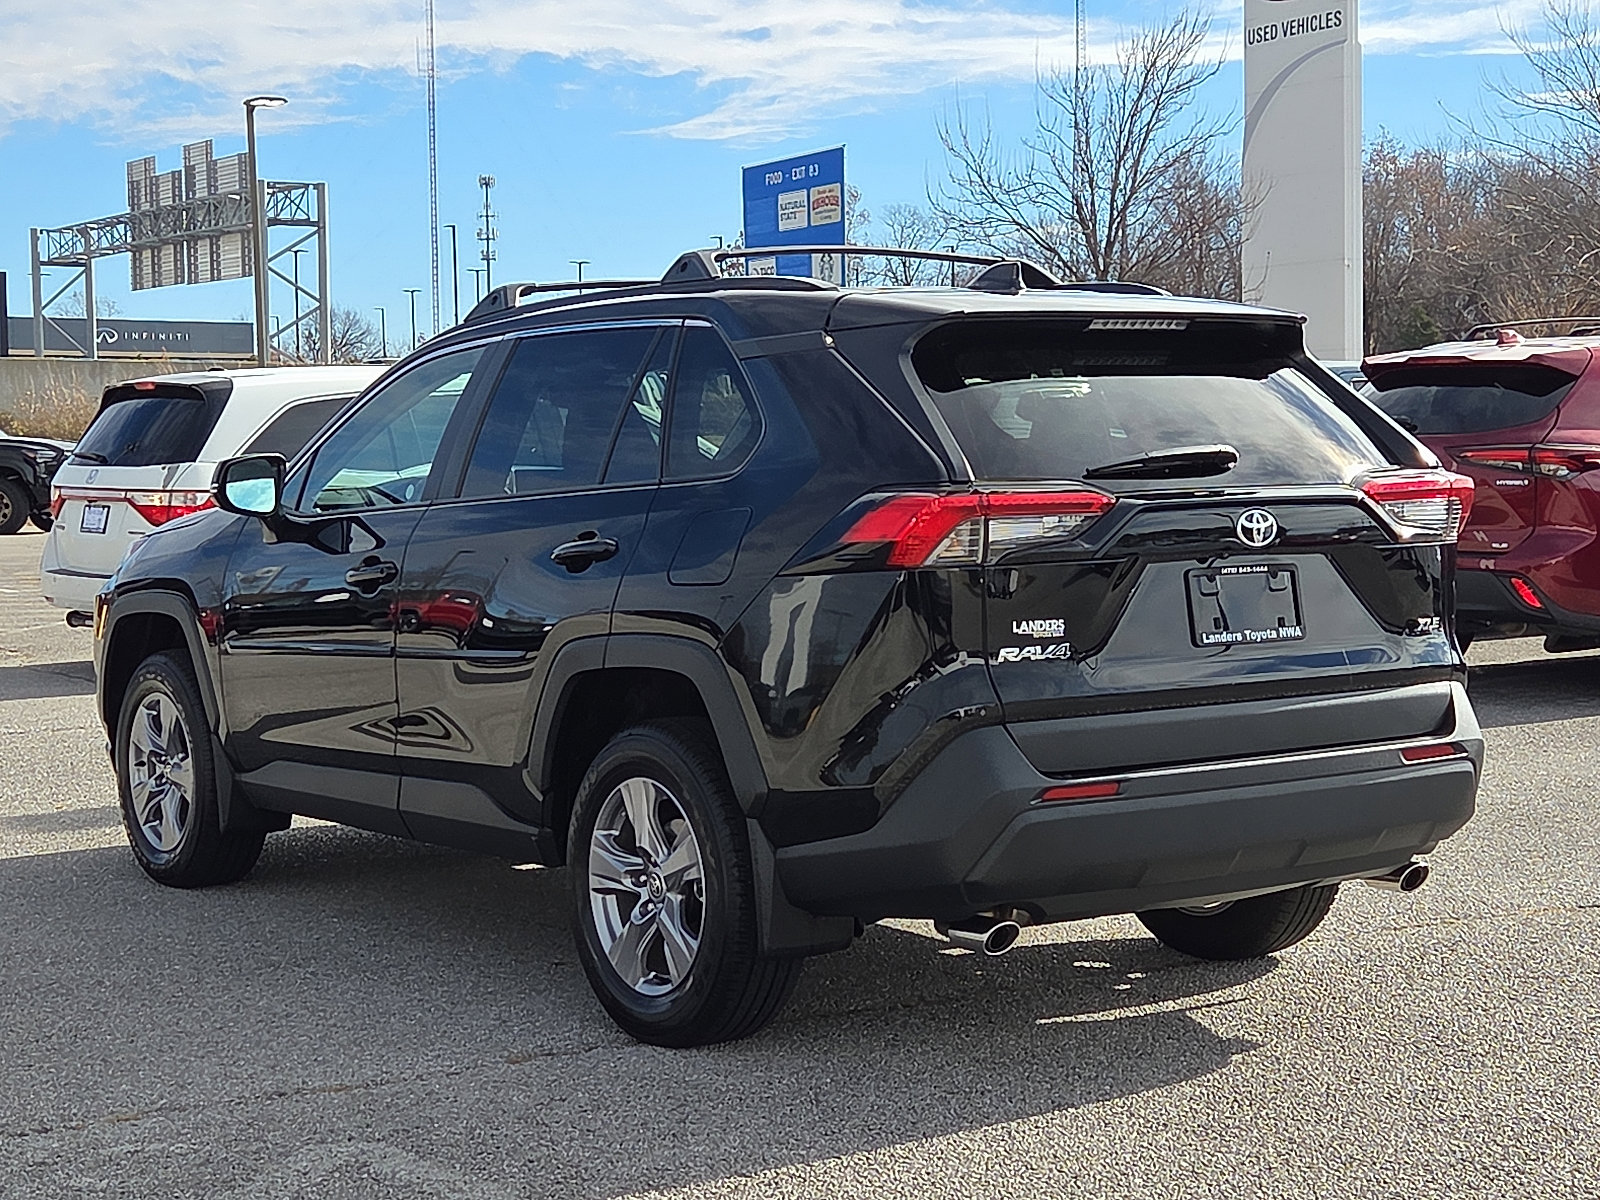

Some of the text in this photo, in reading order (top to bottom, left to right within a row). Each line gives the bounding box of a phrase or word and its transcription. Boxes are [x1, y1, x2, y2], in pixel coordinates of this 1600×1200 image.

[1248, 10, 1342, 45] USED VEHICLES
[765, 171, 782, 185] FOOD
[791, 166, 806, 180] EXIT
[780, 200, 806, 211] NATURAL
[780, 211, 797, 221] STATE
[125, 332, 189, 341] INFINITI
[1012, 619, 1065, 633] LANDERS
[1202, 626, 1302, 643] Landers Toyota NWA
[997, 643, 1071, 662] RAV4
